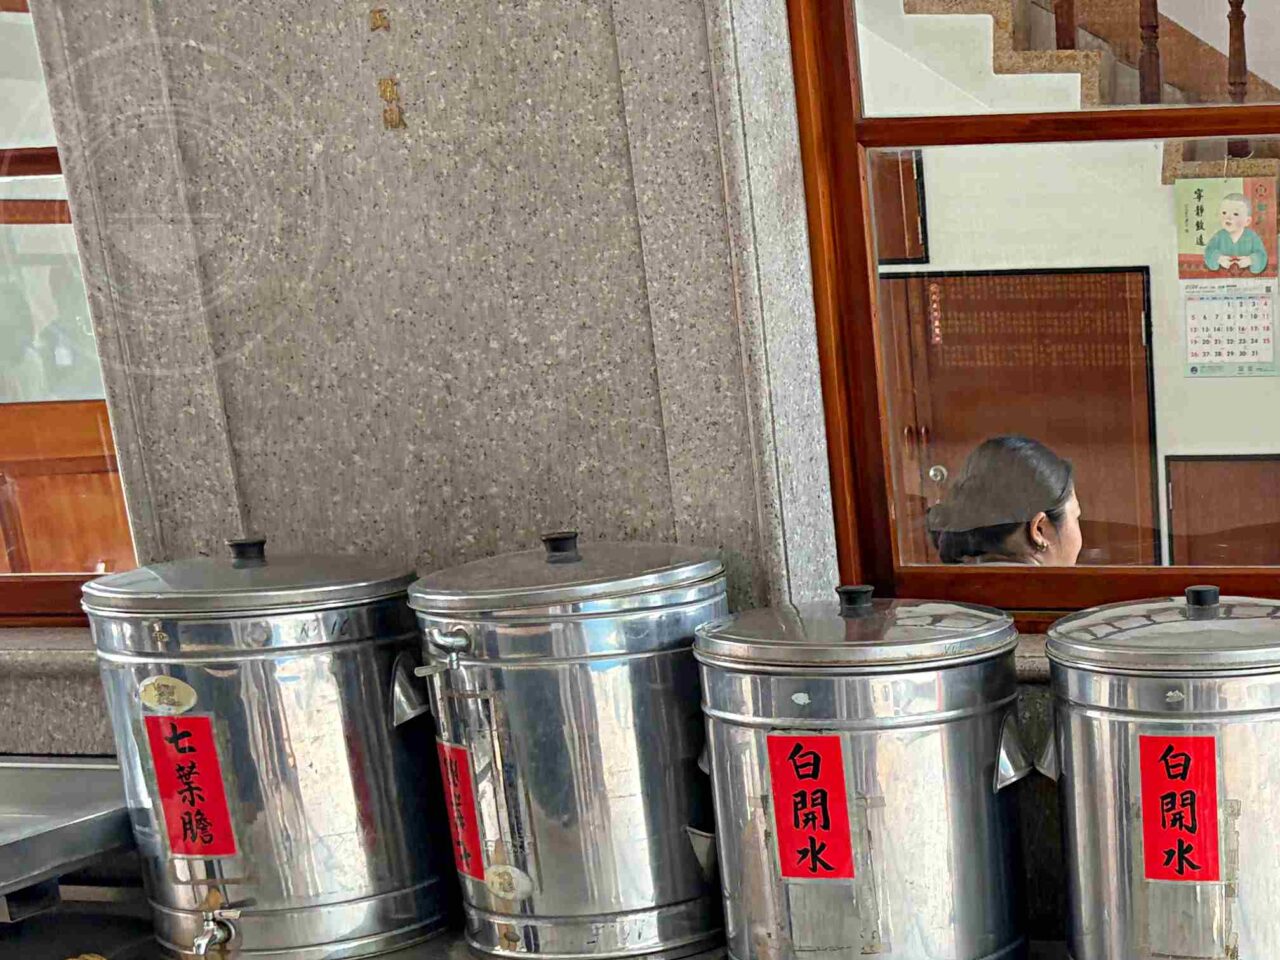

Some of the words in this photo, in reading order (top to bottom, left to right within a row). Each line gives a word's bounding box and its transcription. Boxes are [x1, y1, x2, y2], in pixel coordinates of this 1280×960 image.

[164, 723, 214, 844] 七葉膽
[787, 742, 836, 873] 白開水
[1158, 744, 1202, 875] 白開水
